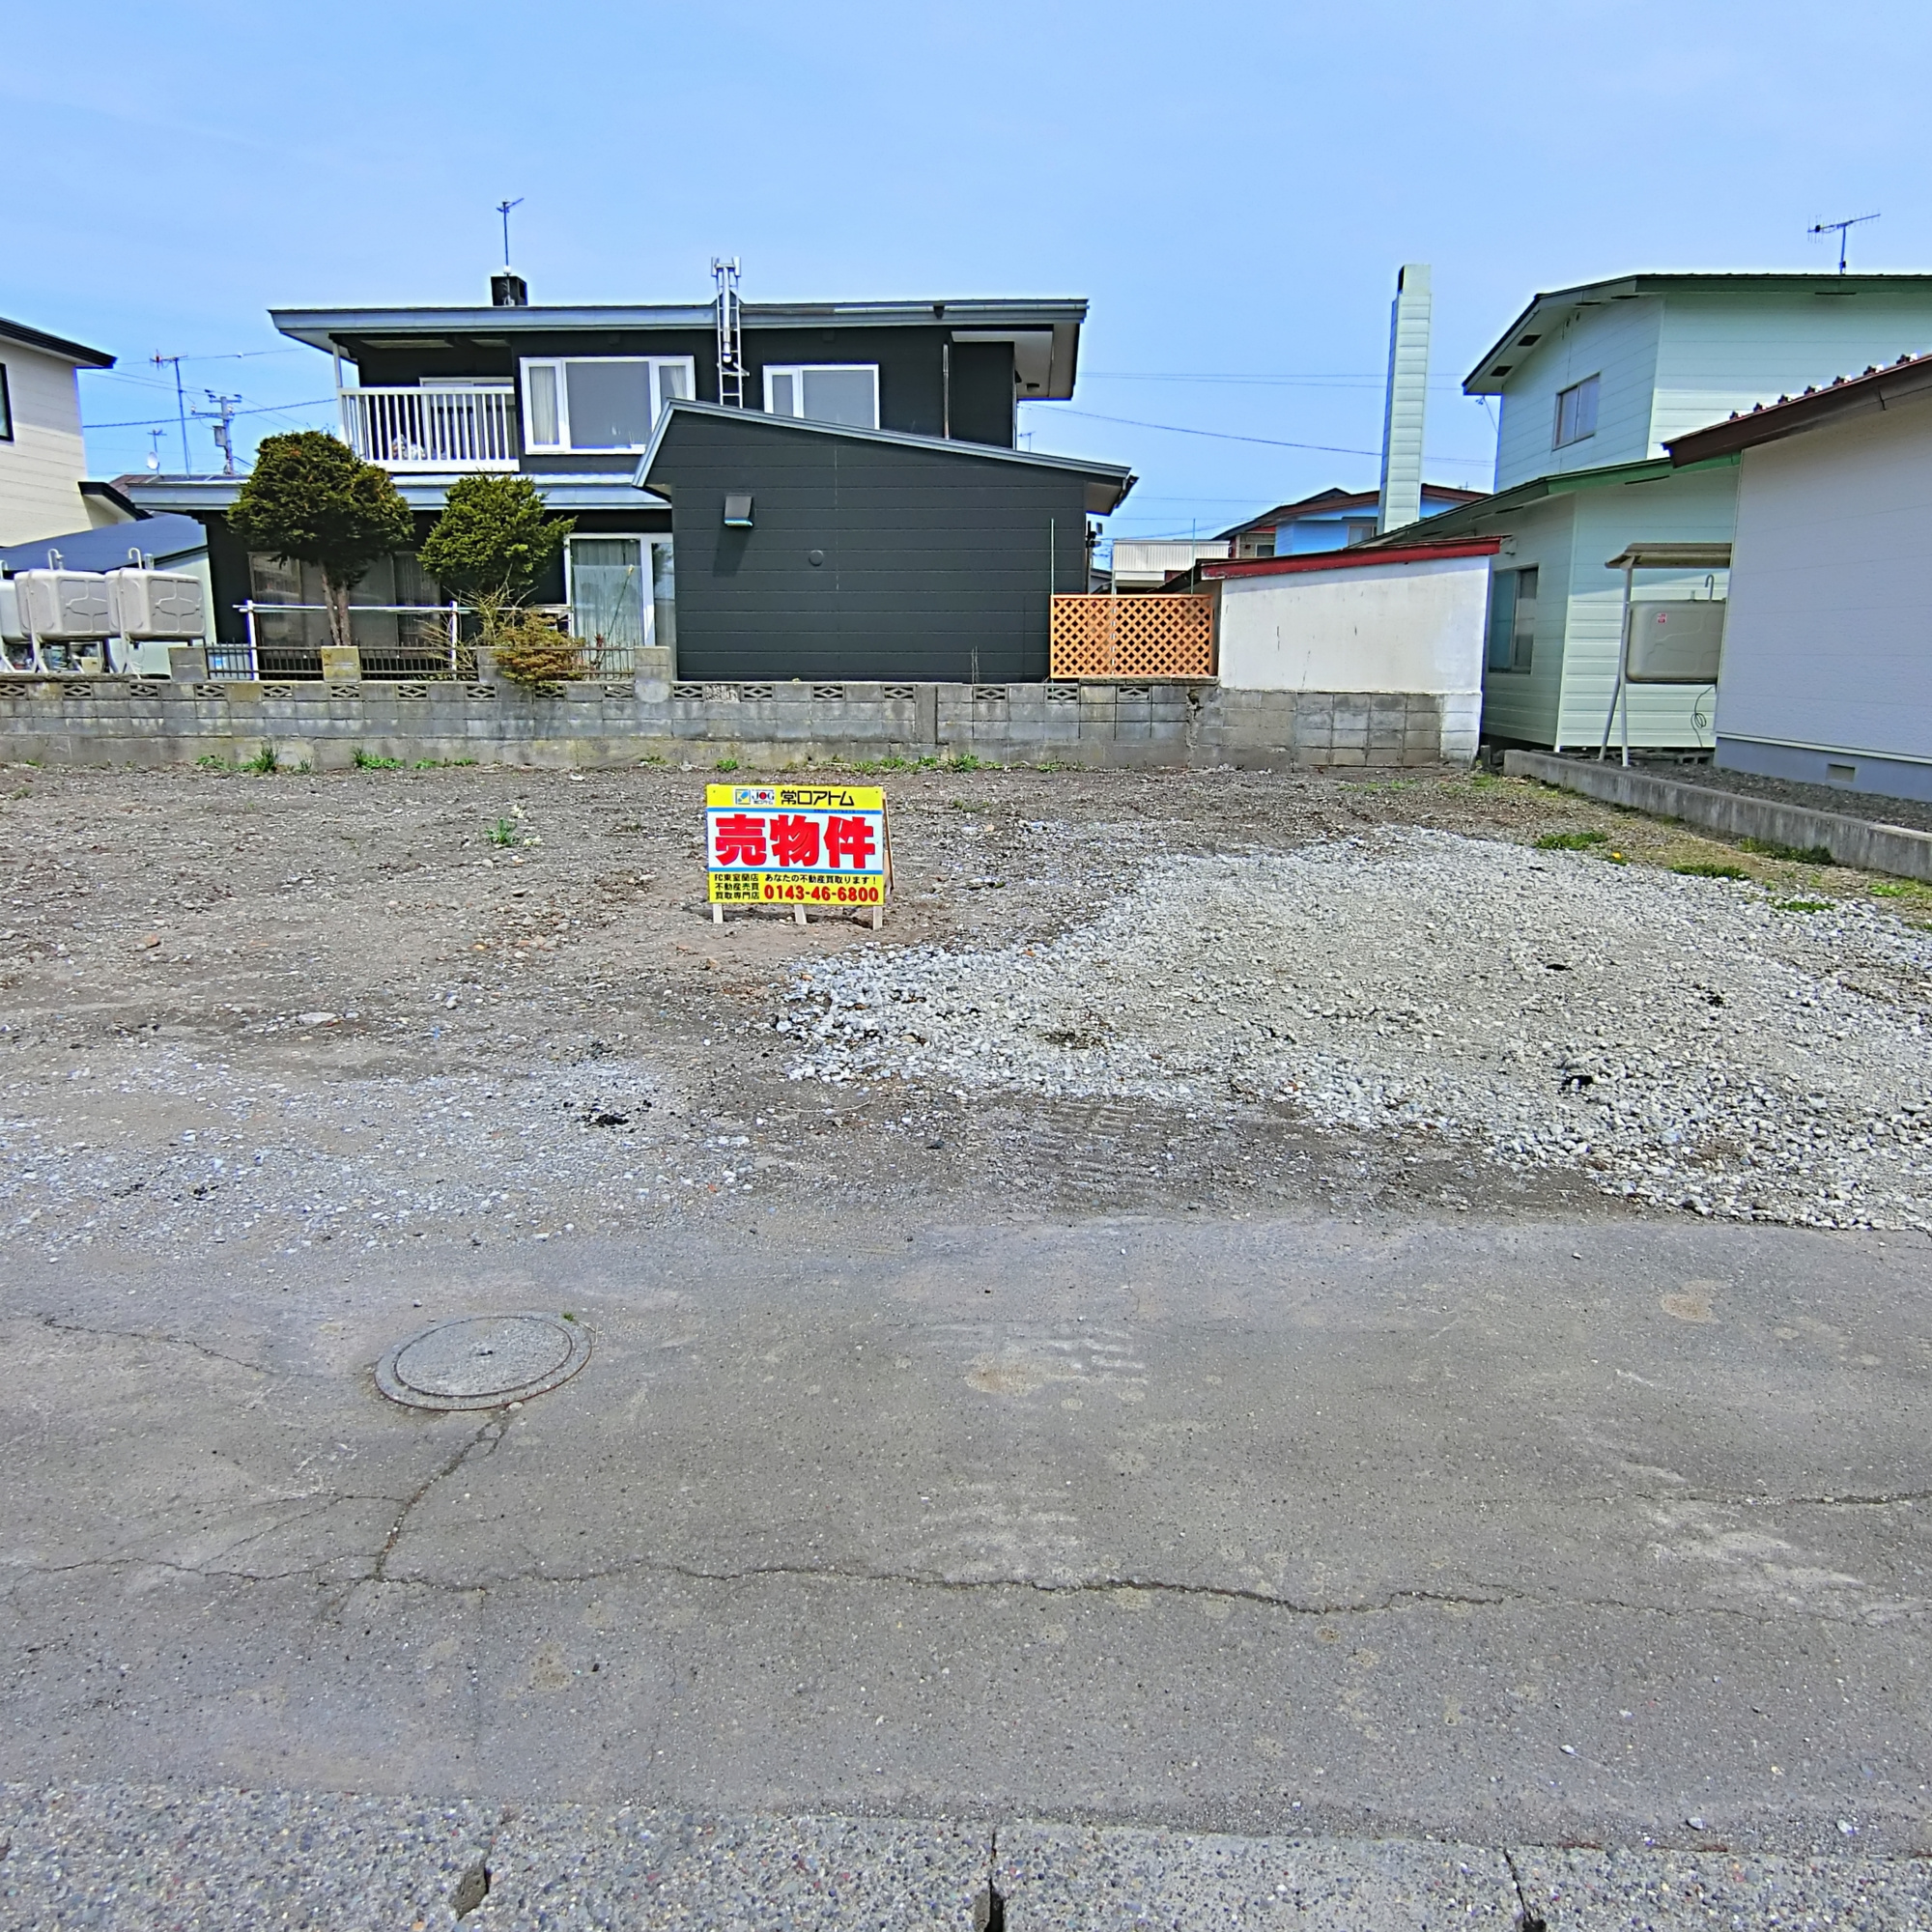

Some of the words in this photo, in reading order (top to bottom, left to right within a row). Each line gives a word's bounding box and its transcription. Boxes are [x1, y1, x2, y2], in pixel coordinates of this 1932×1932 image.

[781, 789, 855, 807] 常口アトム
[715, 814, 875, 868] 売物件
[715, 882, 759, 891] 不動産売買
[764, 884, 879, 902] 0143-46-6800
